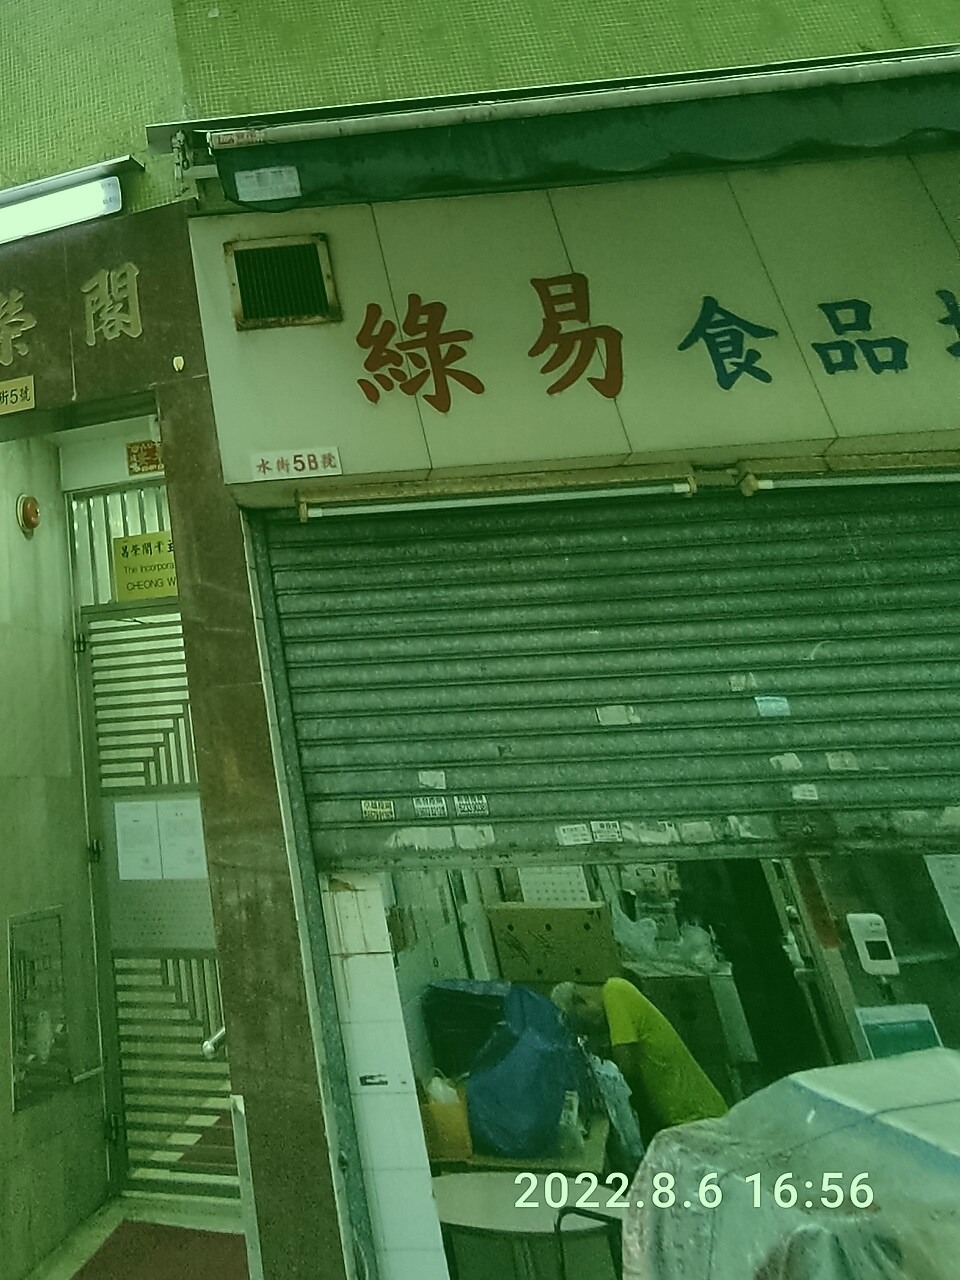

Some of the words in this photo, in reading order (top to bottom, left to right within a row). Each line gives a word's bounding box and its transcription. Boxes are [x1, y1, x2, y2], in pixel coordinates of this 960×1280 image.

[256, 452, 337, 475] 水街5B號
[124, 566, 138, 575] The
[126, 578, 163, 591] CHEONG
